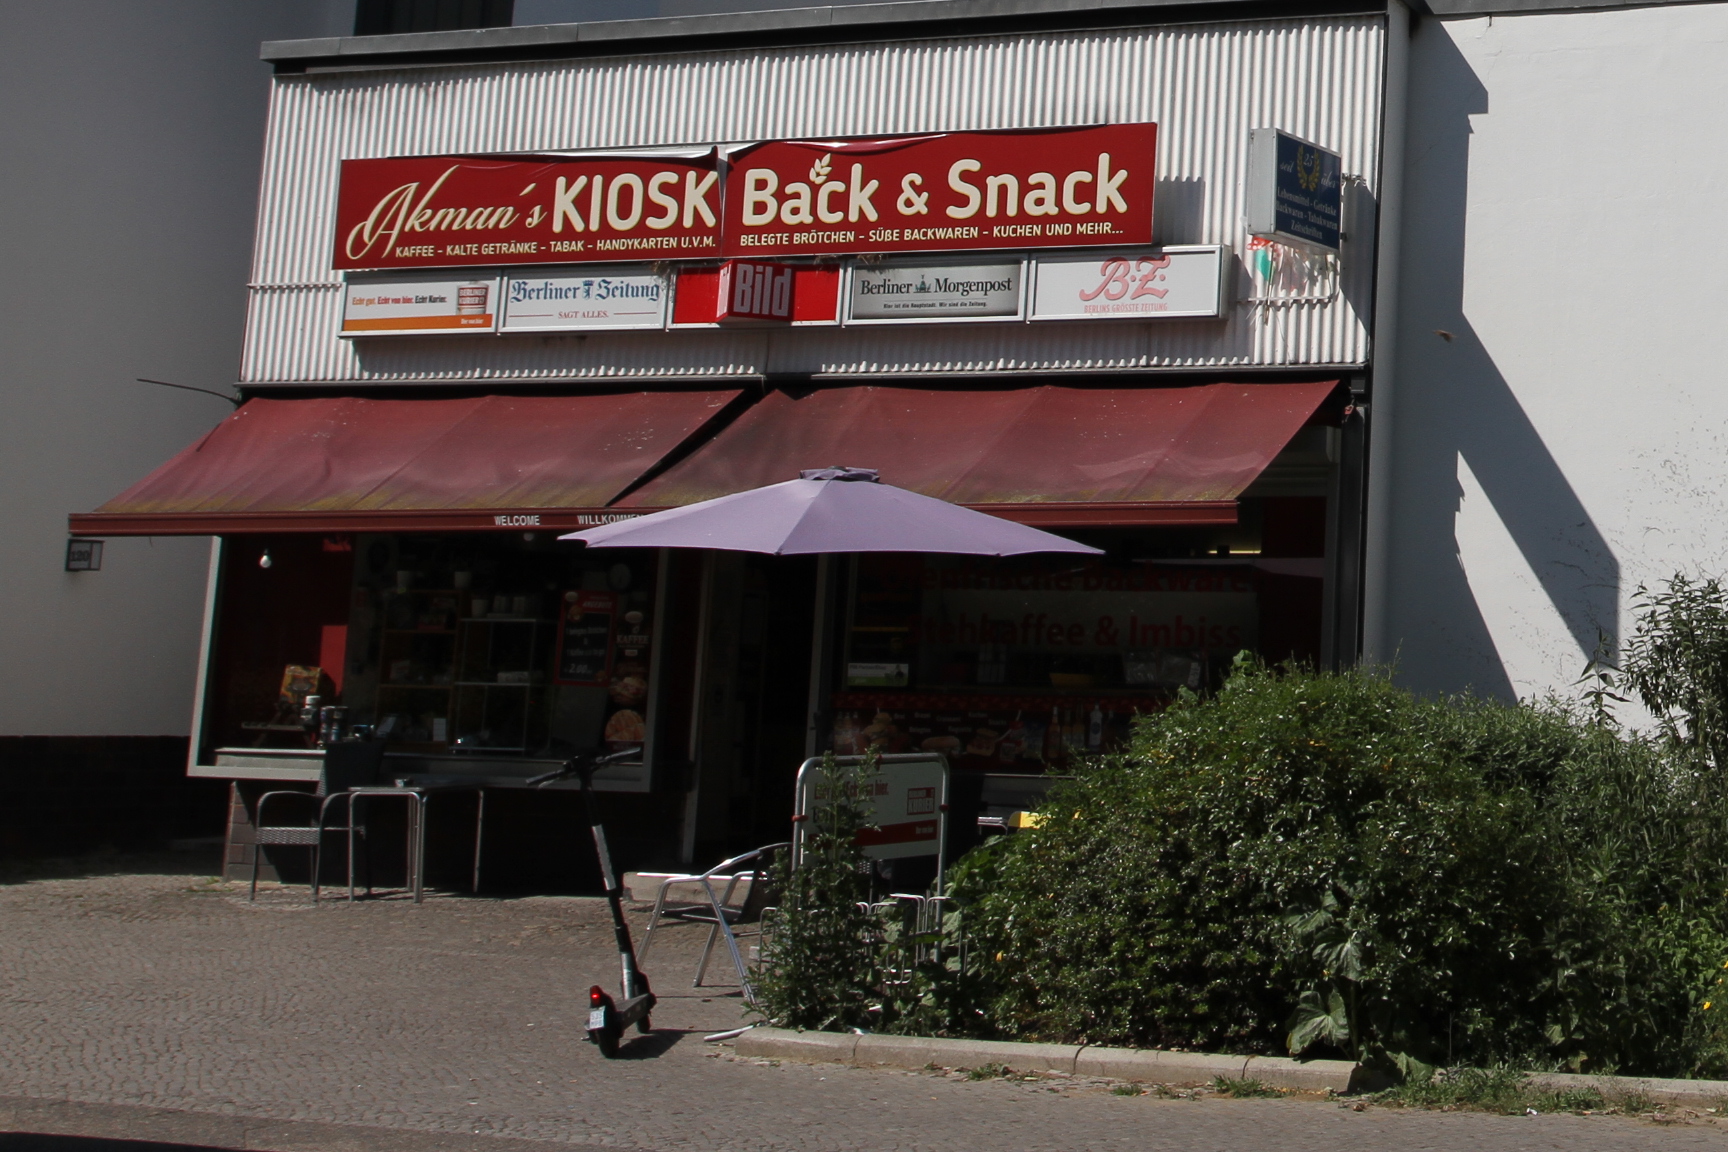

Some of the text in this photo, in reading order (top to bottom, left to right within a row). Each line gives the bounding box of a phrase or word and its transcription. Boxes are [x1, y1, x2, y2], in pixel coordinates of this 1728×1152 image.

[742, 152, 1129, 226] Back & Snack
[552, 170, 718, 234] KIOSK
[740, 232, 789, 246] BELEGTE
[793, 228, 854, 245] BRÖTCHEN
[904, 226, 978, 241] BACKWAREN
[993, 223, 1041, 238] KUCHEN
[1046, 222, 1072, 236] UND
[395, 245, 434, 258] KAFFEE
[446, 243, 478, 256] KALTE
[481, 239, 537, 255] GETRÄNKE
[550, 239, 585, 252] TABAK
[597, 236, 677, 251] HANDYKARTEN
[680, 235, 716, 249] U.V.M.
[511, 279, 660, 303] Berliner Zeitung
[733, 263, 792, 317] Bild
[861, 278, 1012, 296] Berliner Morgenpost
[1084, 304, 1110, 313] BERLINS
[1141, 302, 1168, 311] ZEITUNG
[494, 515, 540, 526] WELCOME
[1130, 615, 1242, 647] Imbiss
